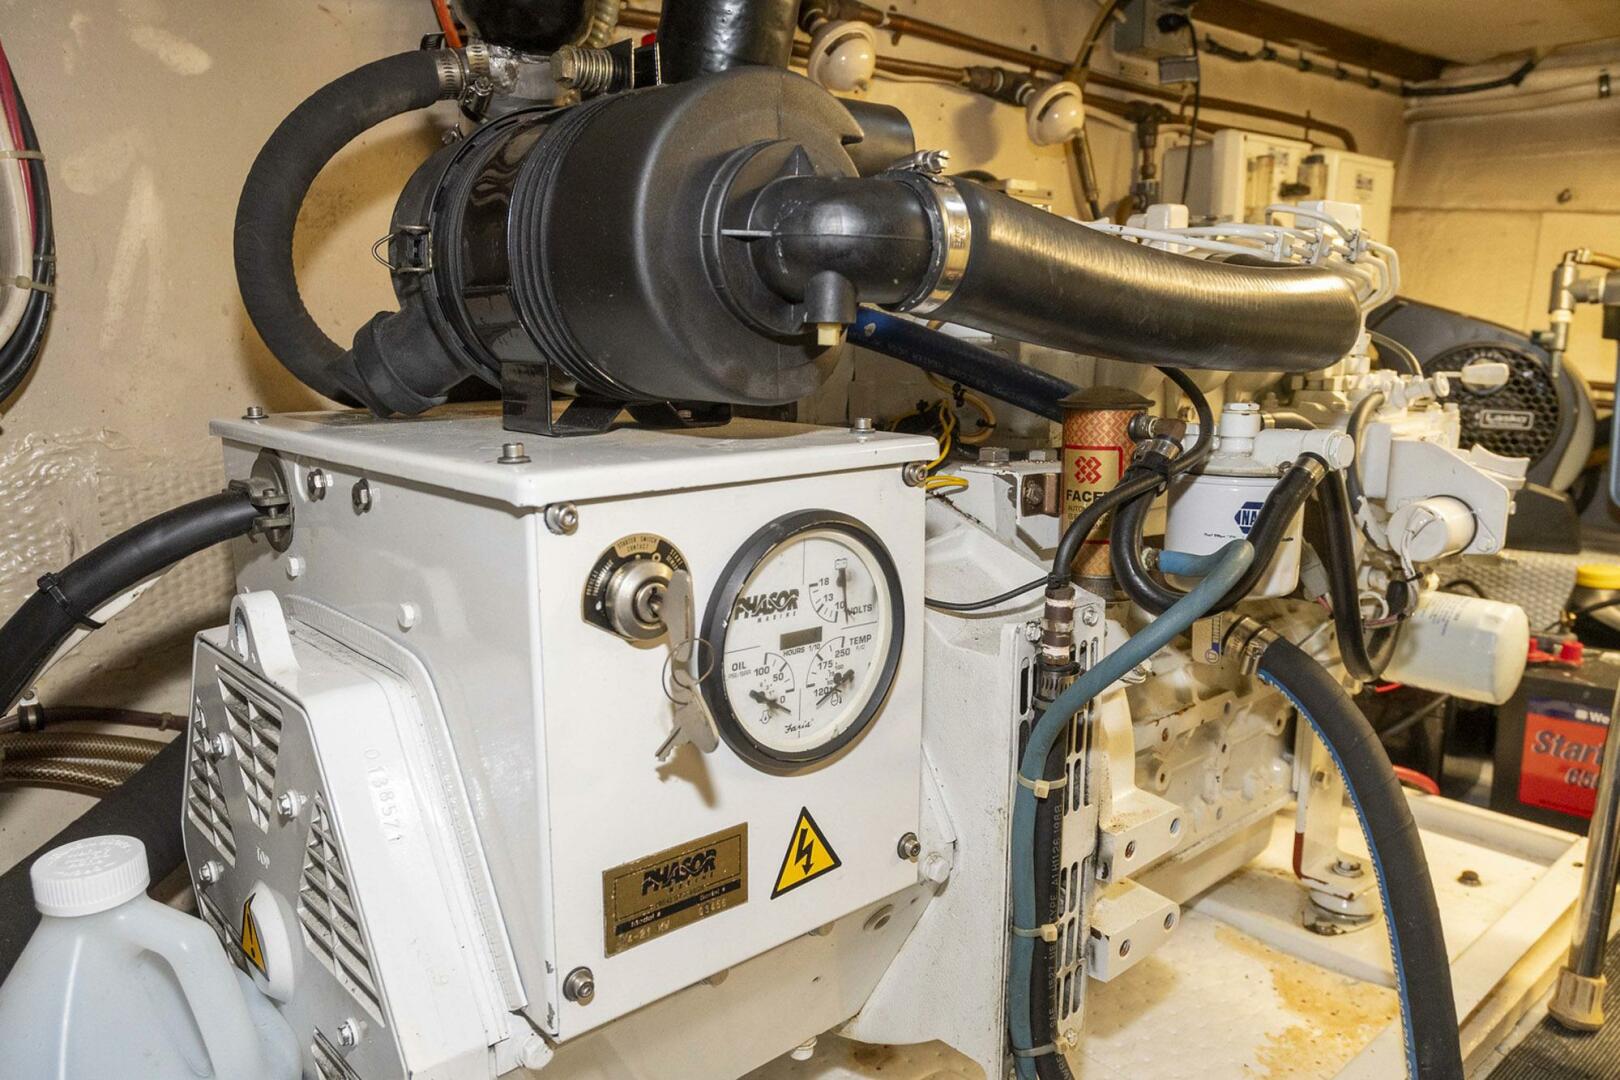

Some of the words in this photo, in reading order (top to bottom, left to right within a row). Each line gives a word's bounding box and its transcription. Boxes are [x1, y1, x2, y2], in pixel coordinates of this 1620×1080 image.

[1241, 510, 1258, 526] NA
[819, 577, 830, 586] 18
[823, 593, 834, 602] 13
[734, 588, 799, 621] PHASOR
[835, 600, 845, 610] 10
[848, 603, 873, 616] VOLTS
[849, 634, 872, 646] TEMP
[783, 646, 806, 657] HOURS
[834, 647, 851, 659] 250
[731, 661, 747, 672] OIL
[817, 659, 834, 671] 175
[753, 666, 770, 677] 100
[772, 672, 784, 682] 50
[780, 695, 786, 704] 0
[642, 848, 717, 896] PHASOR
